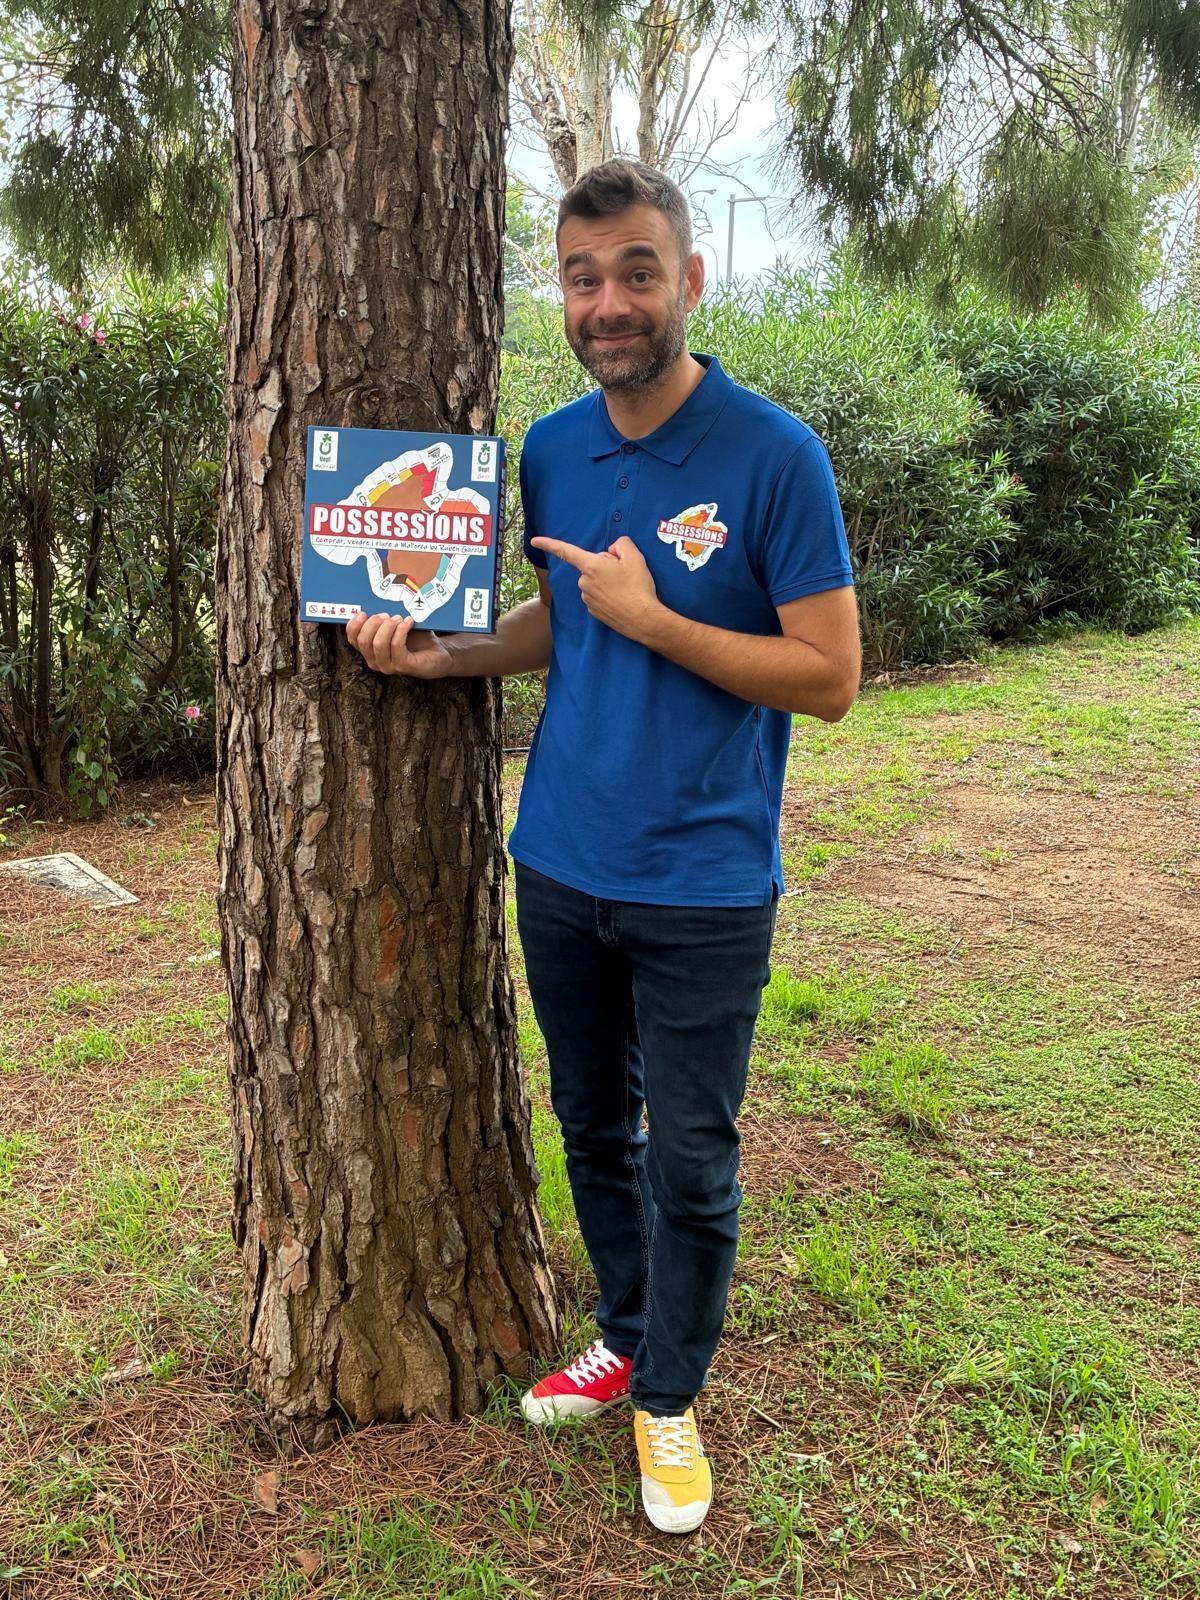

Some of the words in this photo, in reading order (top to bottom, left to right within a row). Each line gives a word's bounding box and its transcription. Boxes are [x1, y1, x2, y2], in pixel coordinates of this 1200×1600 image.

[313, 506, 484, 543] POSSESSIONS
[660, 521, 724, 544] POSSESSIONS
[315, 536, 346, 545] Comprar,
[347, 538, 370, 546] vendre
